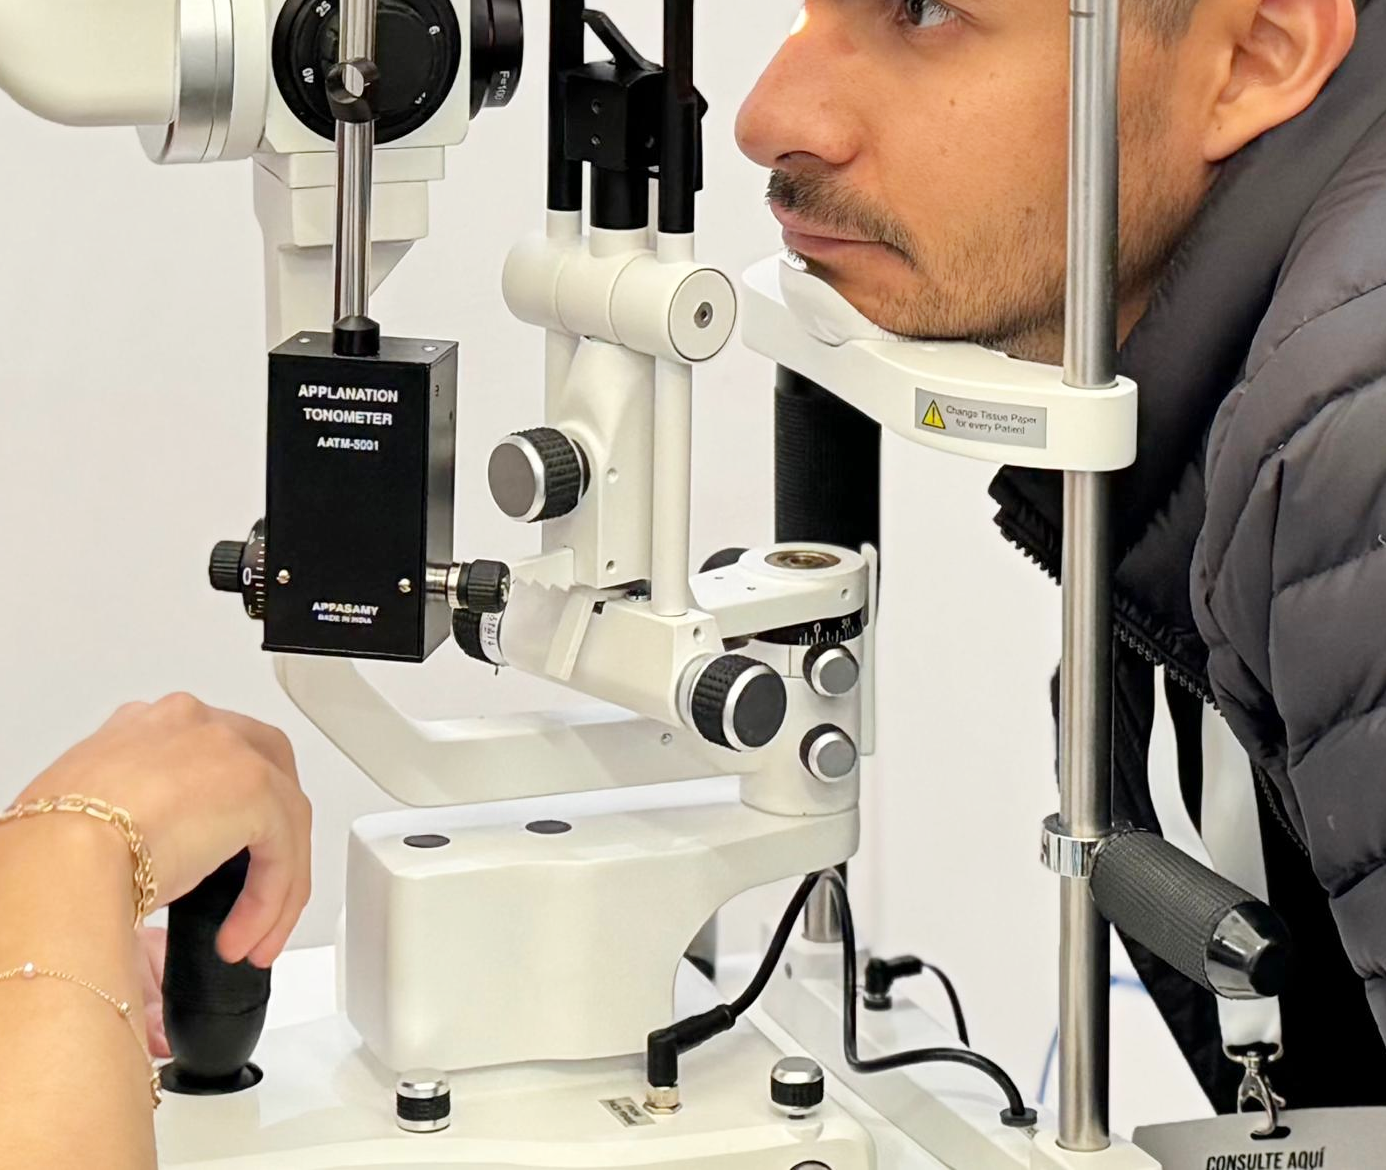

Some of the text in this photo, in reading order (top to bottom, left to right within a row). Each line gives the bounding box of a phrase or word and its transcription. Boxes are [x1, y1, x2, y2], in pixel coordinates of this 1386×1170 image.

[298, 384, 399, 403] APPLANATION
[303, 407, 393, 426] TONOMETER
[946, 405, 978, 420] Change
[980, 410, 1009, 422] Tissue
[968, 421, 992, 433] every
[312, 601, 380, 616] APPASAMY
[1206, 1146, 1326, 1170] CONSULTE AQUÍ
